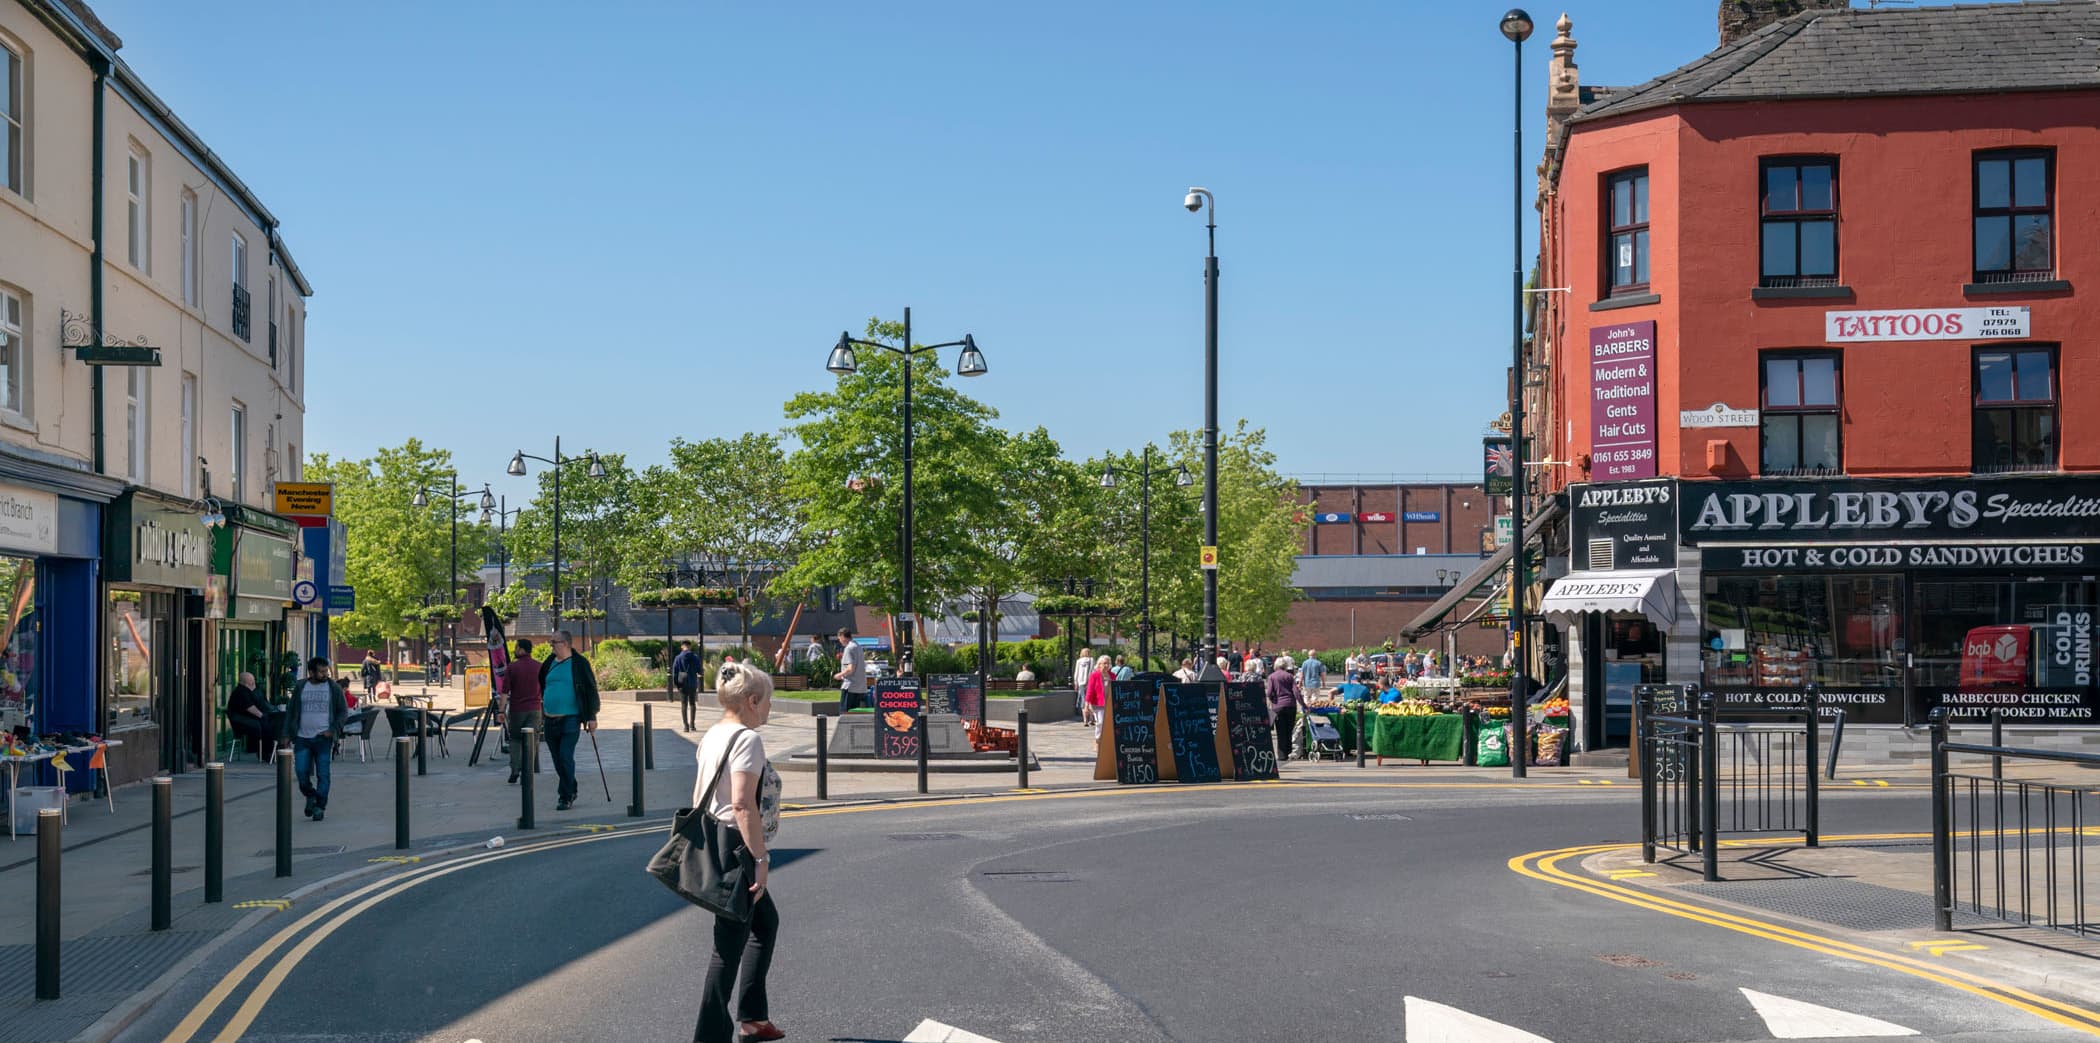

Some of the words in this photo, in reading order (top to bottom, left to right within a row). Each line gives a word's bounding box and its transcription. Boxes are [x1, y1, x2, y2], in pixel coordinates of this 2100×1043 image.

[1990, 309, 2010, 317] TEL:
[1834, 313, 1963, 337] TATTOOS
[1983, 319, 2017, 327] 07979
[1607, 328, 1635, 340] John's
[2001, 328, 2022, 336] 068
[1595, 339, 1649, 357] BARBERS
[1595, 366, 1636, 382] Modern
[1638, 363, 1647, 377] &
[1595, 382, 1650, 401] Traditional
[1606, 405, 1638, 418] Gents
[1683, 414, 1714, 424] WOOD
[1718, 414, 1755, 424] STREET
[1600, 424, 1620, 437] Hair
[1622, 423, 1646, 436] Cuts
[1593, 452, 1611, 464] 0161
[1614, 451, 1629, 462] 655
[1631, 449, 1653, 461] 3849
[1609, 466, 1620, 475] Est.
[286, 496, 321, 504] Evening
[1578, 487, 1670, 508] APPLEBY'S
[11, 496, 33, 520] Branch
[1690, 491, 1979, 531] APPLEBY'S
[1982, 493, 2100, 523] Specialiti
[1597, 511, 1648, 526] Specialities
[1623, 534, 1643, 543] Quality
[1742, 549, 1799, 568] HOT
[1805, 549, 1825, 567] &
[1830, 548, 1903, 567] COLD
[1909, 546, 2084, 566] SANDWICHES
[1555, 584, 1642, 596] APPLEBY'S
[2055, 611, 2072, 665] COLD
[2075, 611, 2091, 685] DRINKS
[1726, 693, 1751, 703] HOT
[1754, 693, 1764, 703] &
[1767, 693, 1800, 703] COLD
[1804, 693, 1886, 703] NDWICHES
[1942, 694, 2019, 704] BARBECUED
[2021, 694, 2080, 704] CHICKEN
[879, 701, 919, 709] CHICKENS
[1817, 706, 1840, 716] IES
[1947, 707, 1988, 717] ALITY
[1991, 707, 2045, 717] OOKED
[2048, 707, 2092, 717] MEATS
